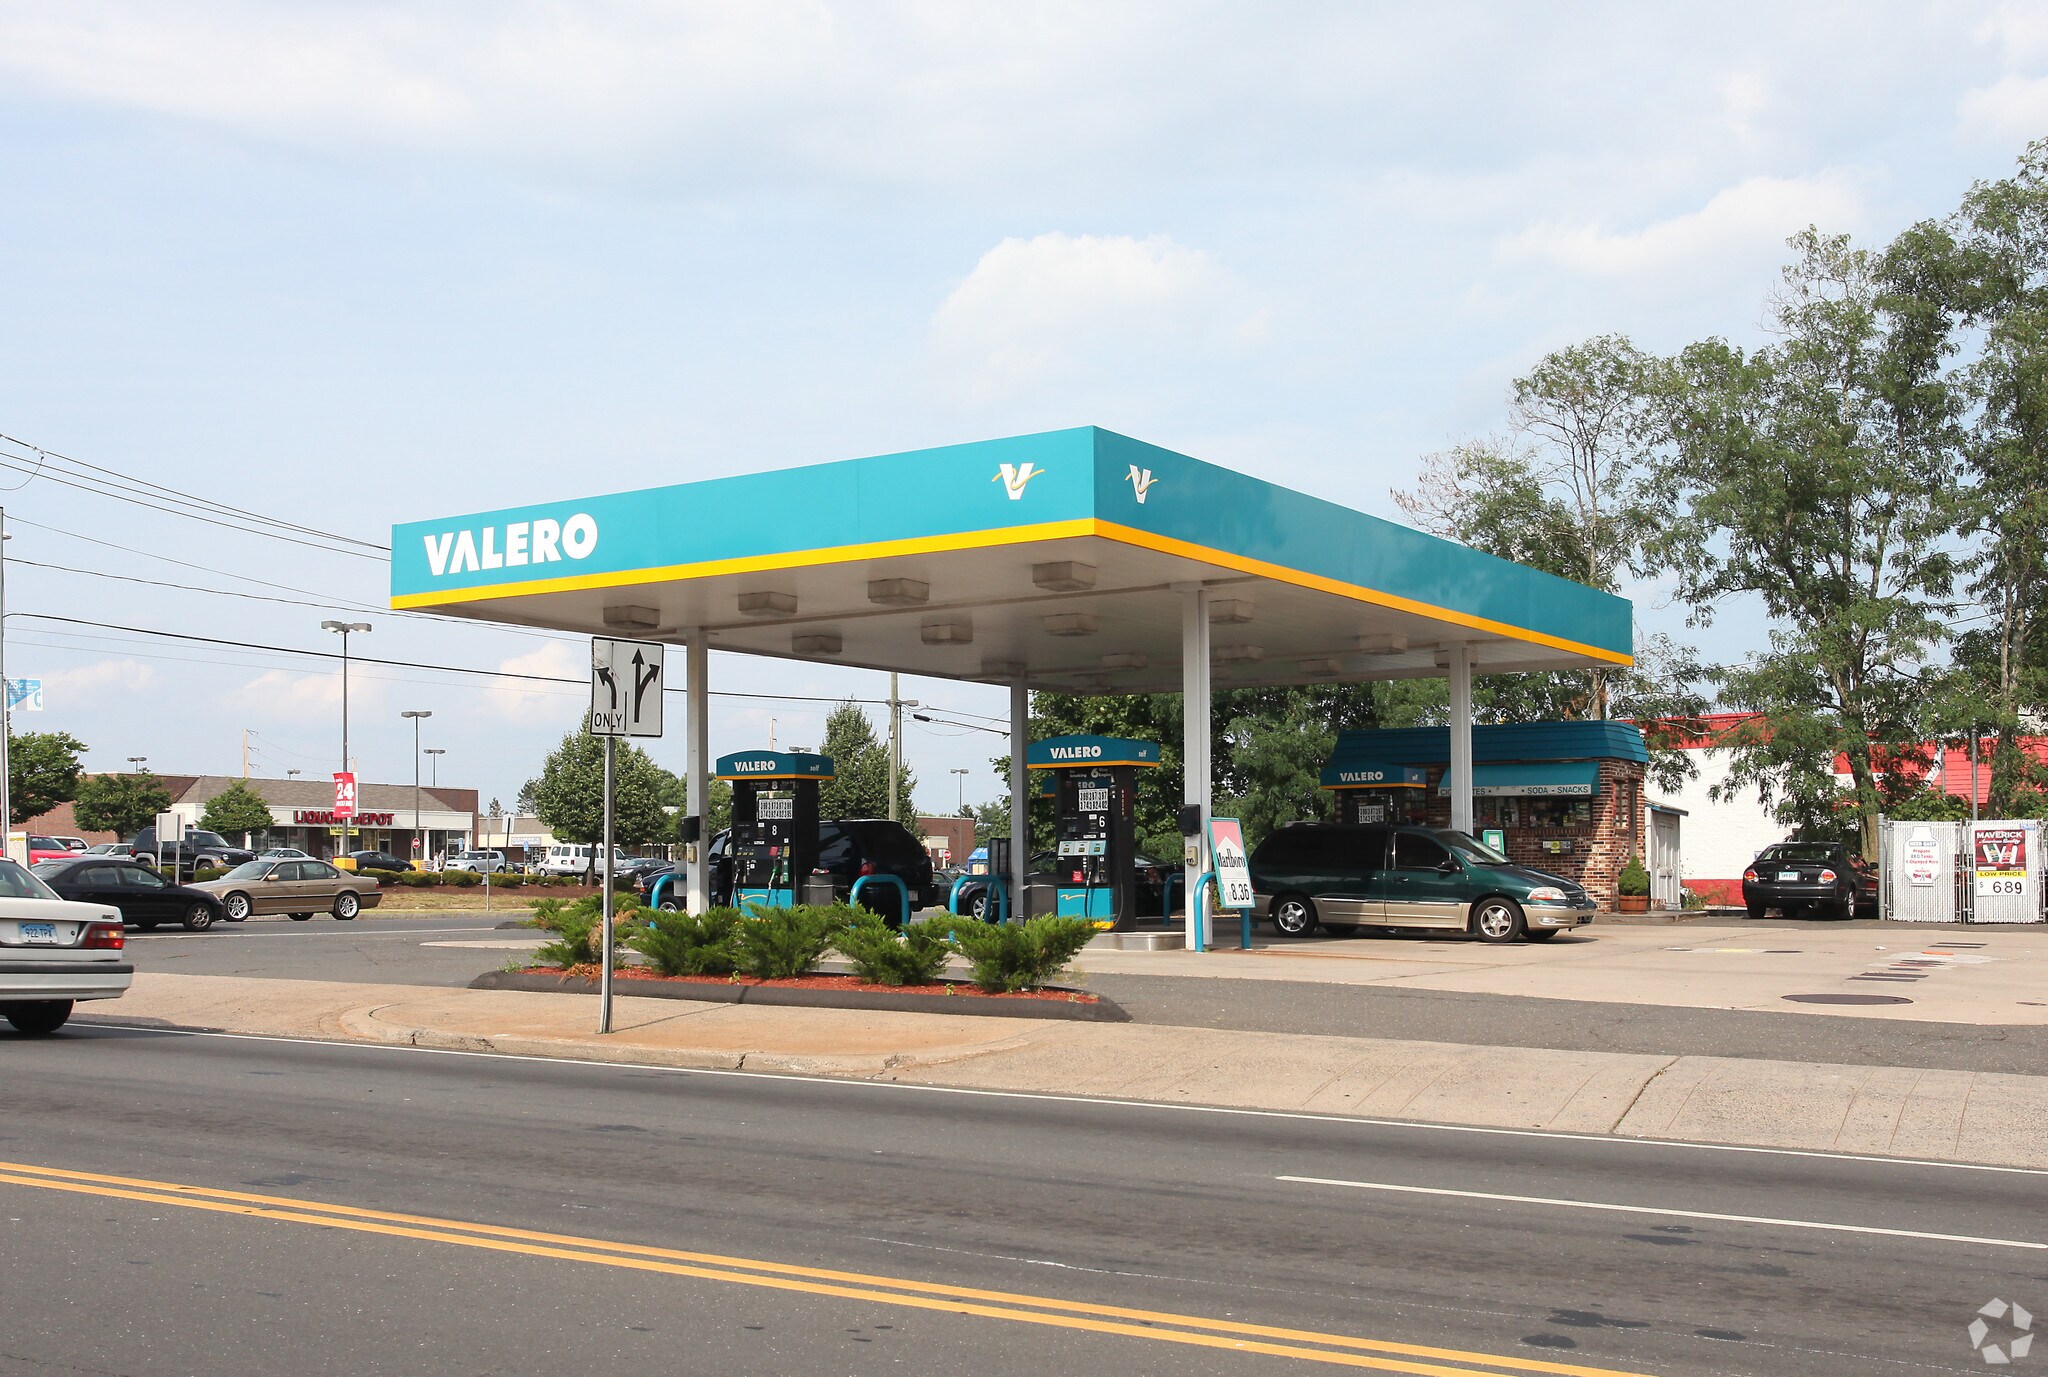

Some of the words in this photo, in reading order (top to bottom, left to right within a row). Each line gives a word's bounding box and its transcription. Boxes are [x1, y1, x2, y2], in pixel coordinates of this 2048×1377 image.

[423, 512, 598, 576] VALERO
[594, 712, 623, 728] ONLY
[1050, 745, 1102, 759] VALERO
[734, 760, 776, 772] VALERO
[1091, 768, 1099, 778] 6
[1339, 771, 1384, 782] VALERO
[336, 782, 355, 800] 24
[771, 780, 778, 790] 8
[1527, 787, 1549, 795] SODA
[1557, 786, 1589, 794] SNACKS
[351, 813, 395, 826] DEPOT
[1099, 815, 1106, 827] 6
[771, 825, 778, 836] 8
[1976, 831, 2023, 839] MAVERICK
[1218, 848, 1246, 868] Marlboro
[1231, 883, 1250, 900] 8.36
